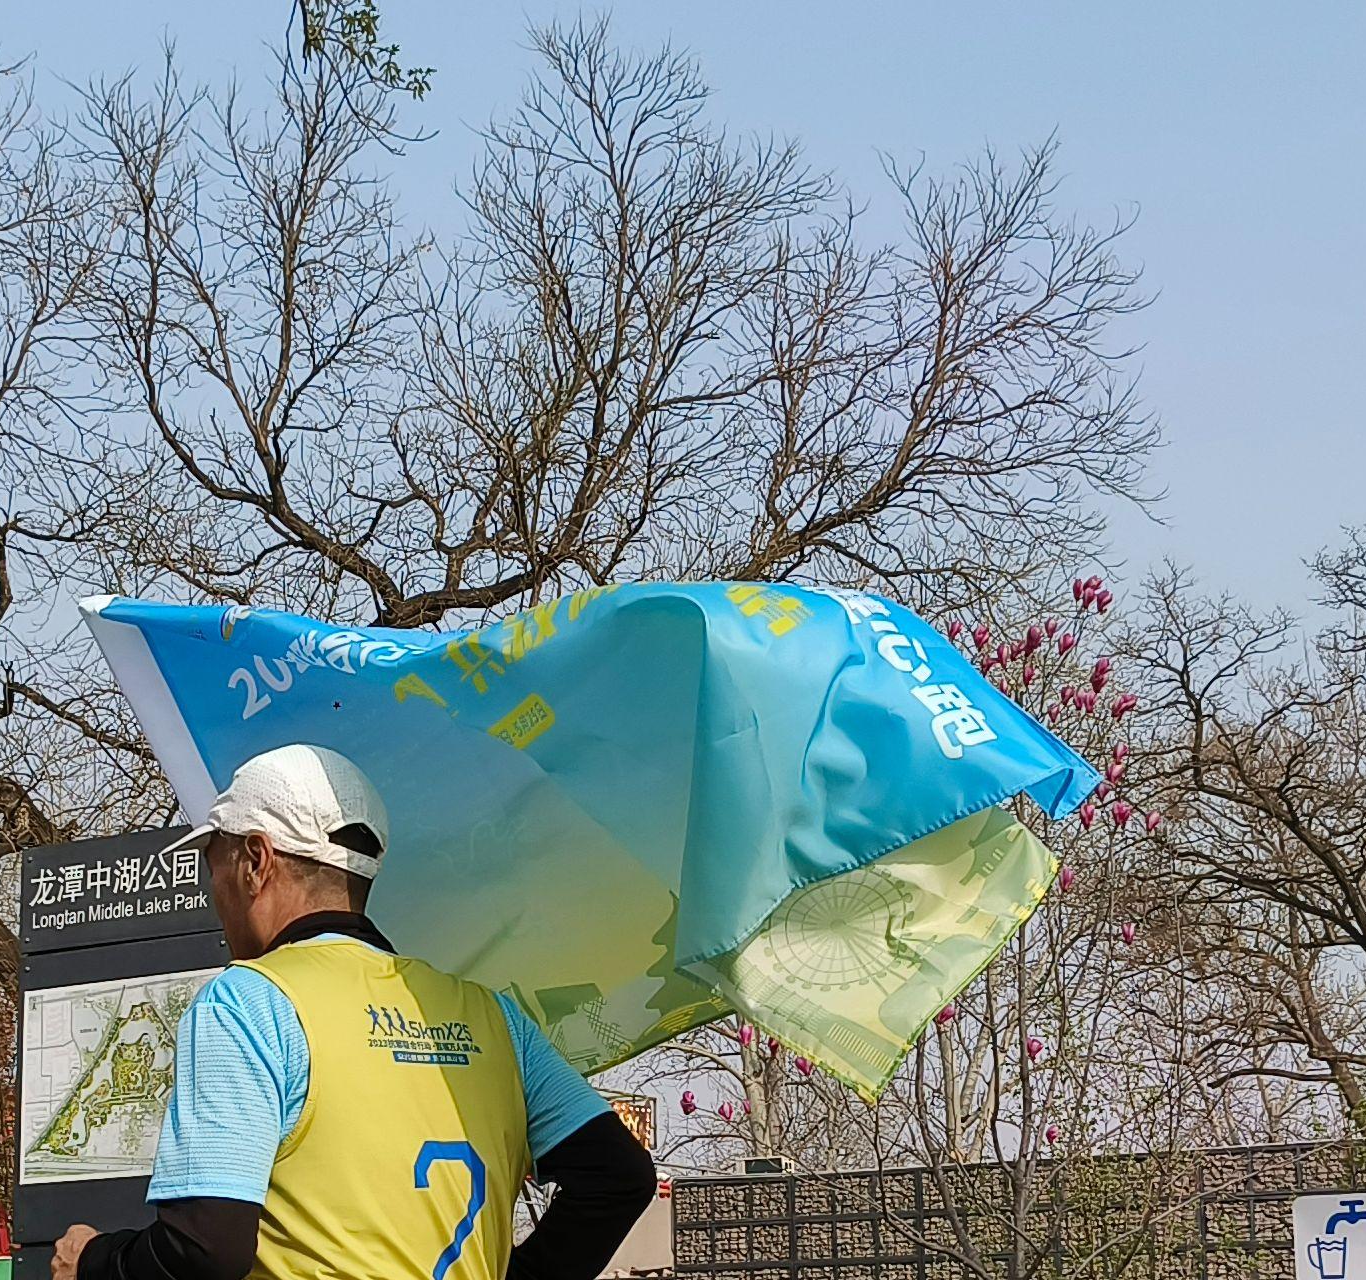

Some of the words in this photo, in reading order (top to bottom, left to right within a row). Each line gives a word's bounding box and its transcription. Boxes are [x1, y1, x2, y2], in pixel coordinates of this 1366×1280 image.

[29, 849, 200, 907] 龙潭中湖公园
[32, 909, 85, 930] Longtan
[88, 901, 134, 922] Middle
[137, 897, 171, 916] Lake
[174, 891, 208, 911] Park
[409, 1021, 473, 1042] 5kmX25
